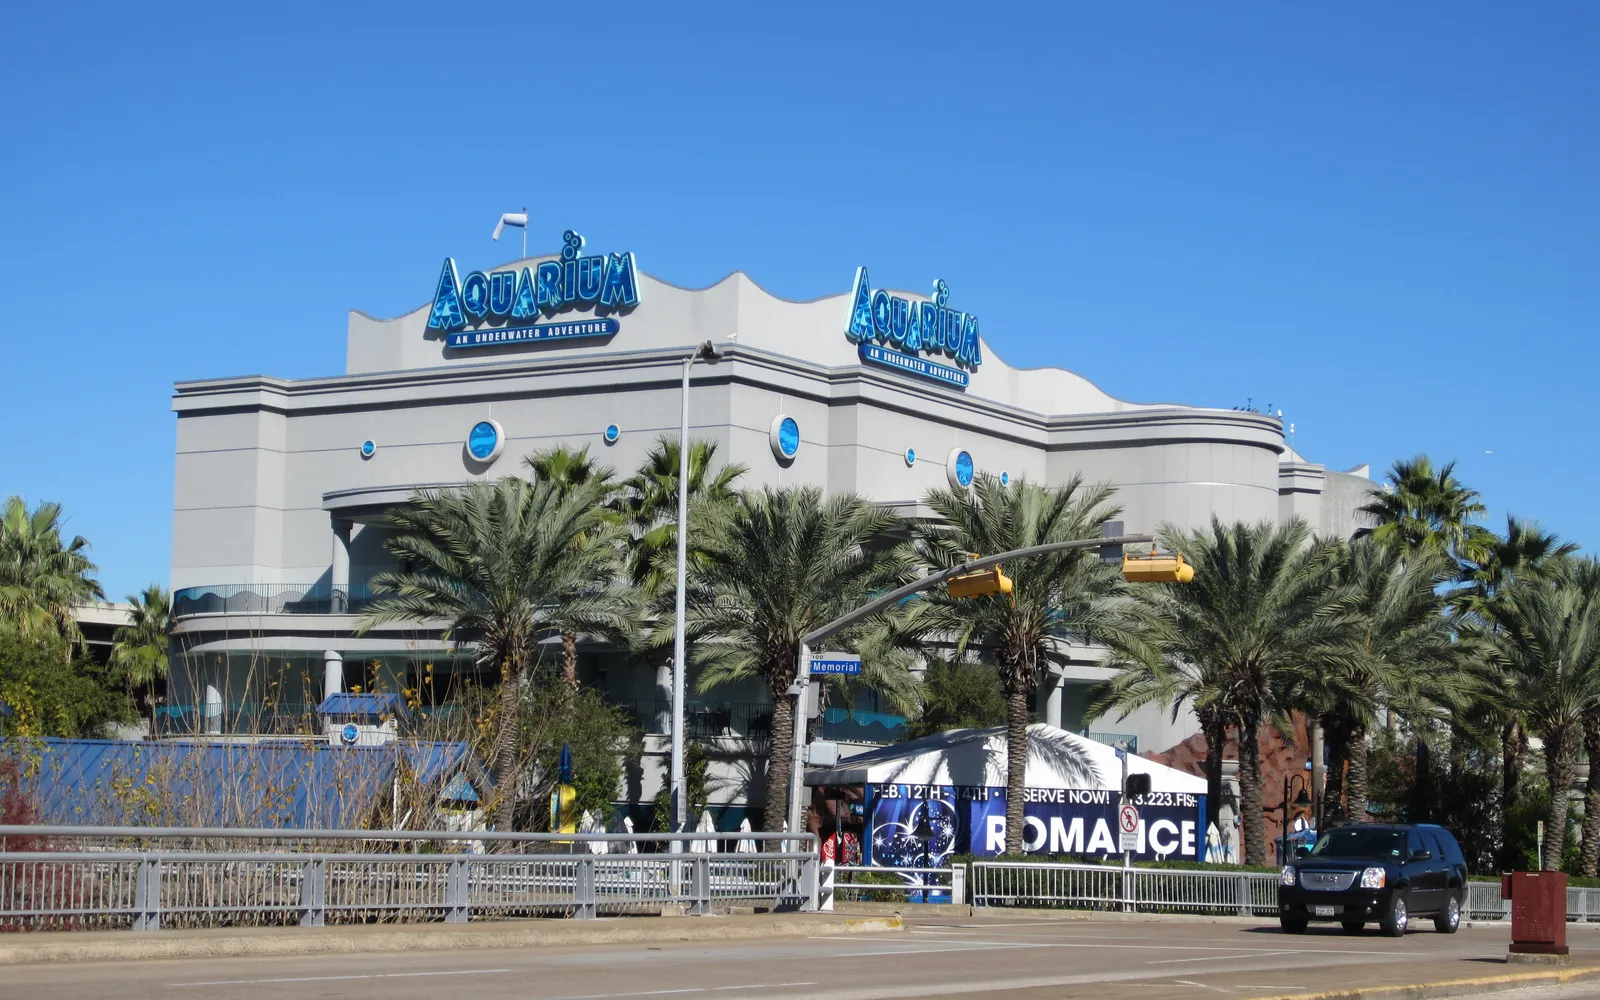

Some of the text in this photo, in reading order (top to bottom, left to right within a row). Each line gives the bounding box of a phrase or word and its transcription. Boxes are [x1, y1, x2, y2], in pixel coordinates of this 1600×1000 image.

[427, 230, 640, 331] AQUARIUM
[844, 266, 982, 366] AQUARIUM
[455, 322, 607, 345] AN UNDERWATER ADVENTURE
[869, 348, 965, 384] AN UNDERWATER ADVENTURE
[813, 662, 857, 672] Memorial
[905, 785, 940, 800] 12TH
[1005, 788, 1065, 803] SERVE
[1069, 790, 1110, 805] NOW!
[1117, 791, 1198, 808] 73.223.FISH
